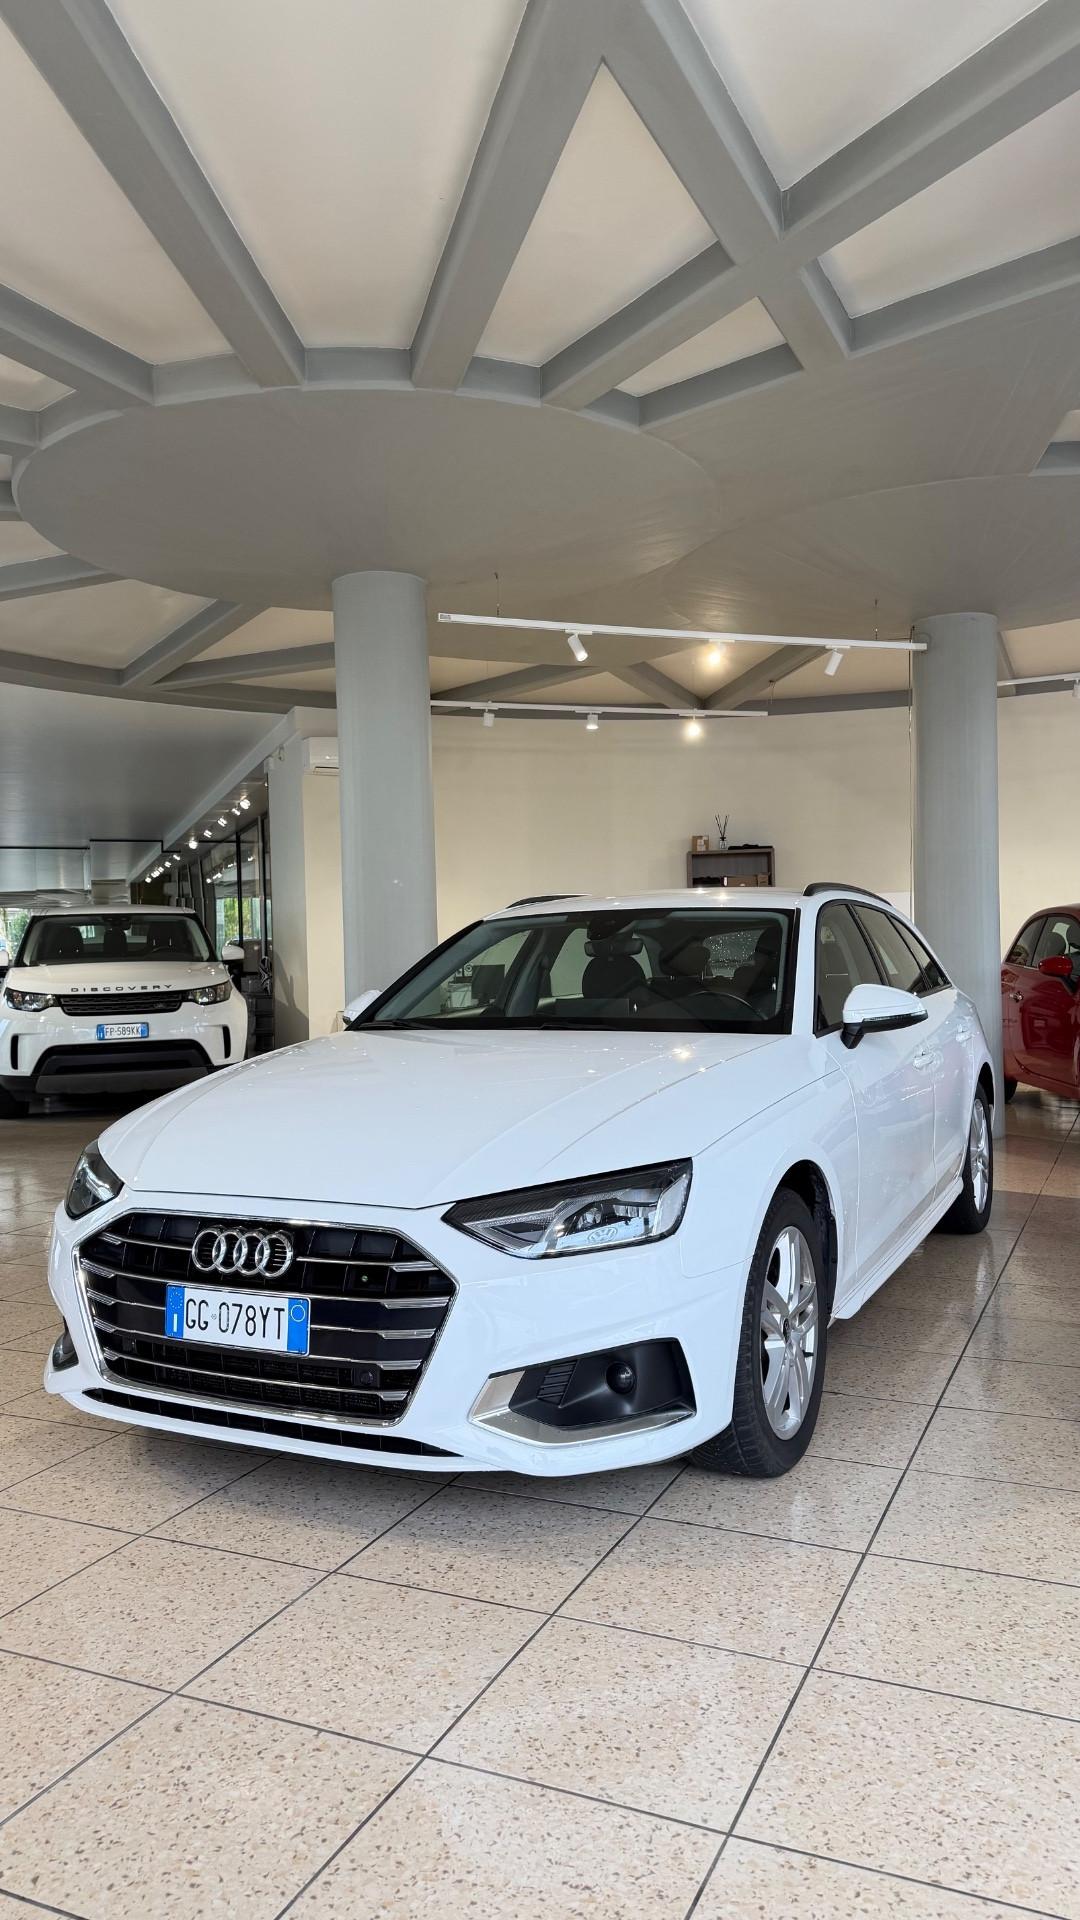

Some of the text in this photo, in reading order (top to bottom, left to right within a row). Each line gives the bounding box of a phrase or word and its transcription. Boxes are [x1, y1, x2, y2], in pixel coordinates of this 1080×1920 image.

[71, 984, 172, 993] DISCOVERY
[185, 1298, 209, 1331] GG
[218, 1301, 285, 1340] 078YT
